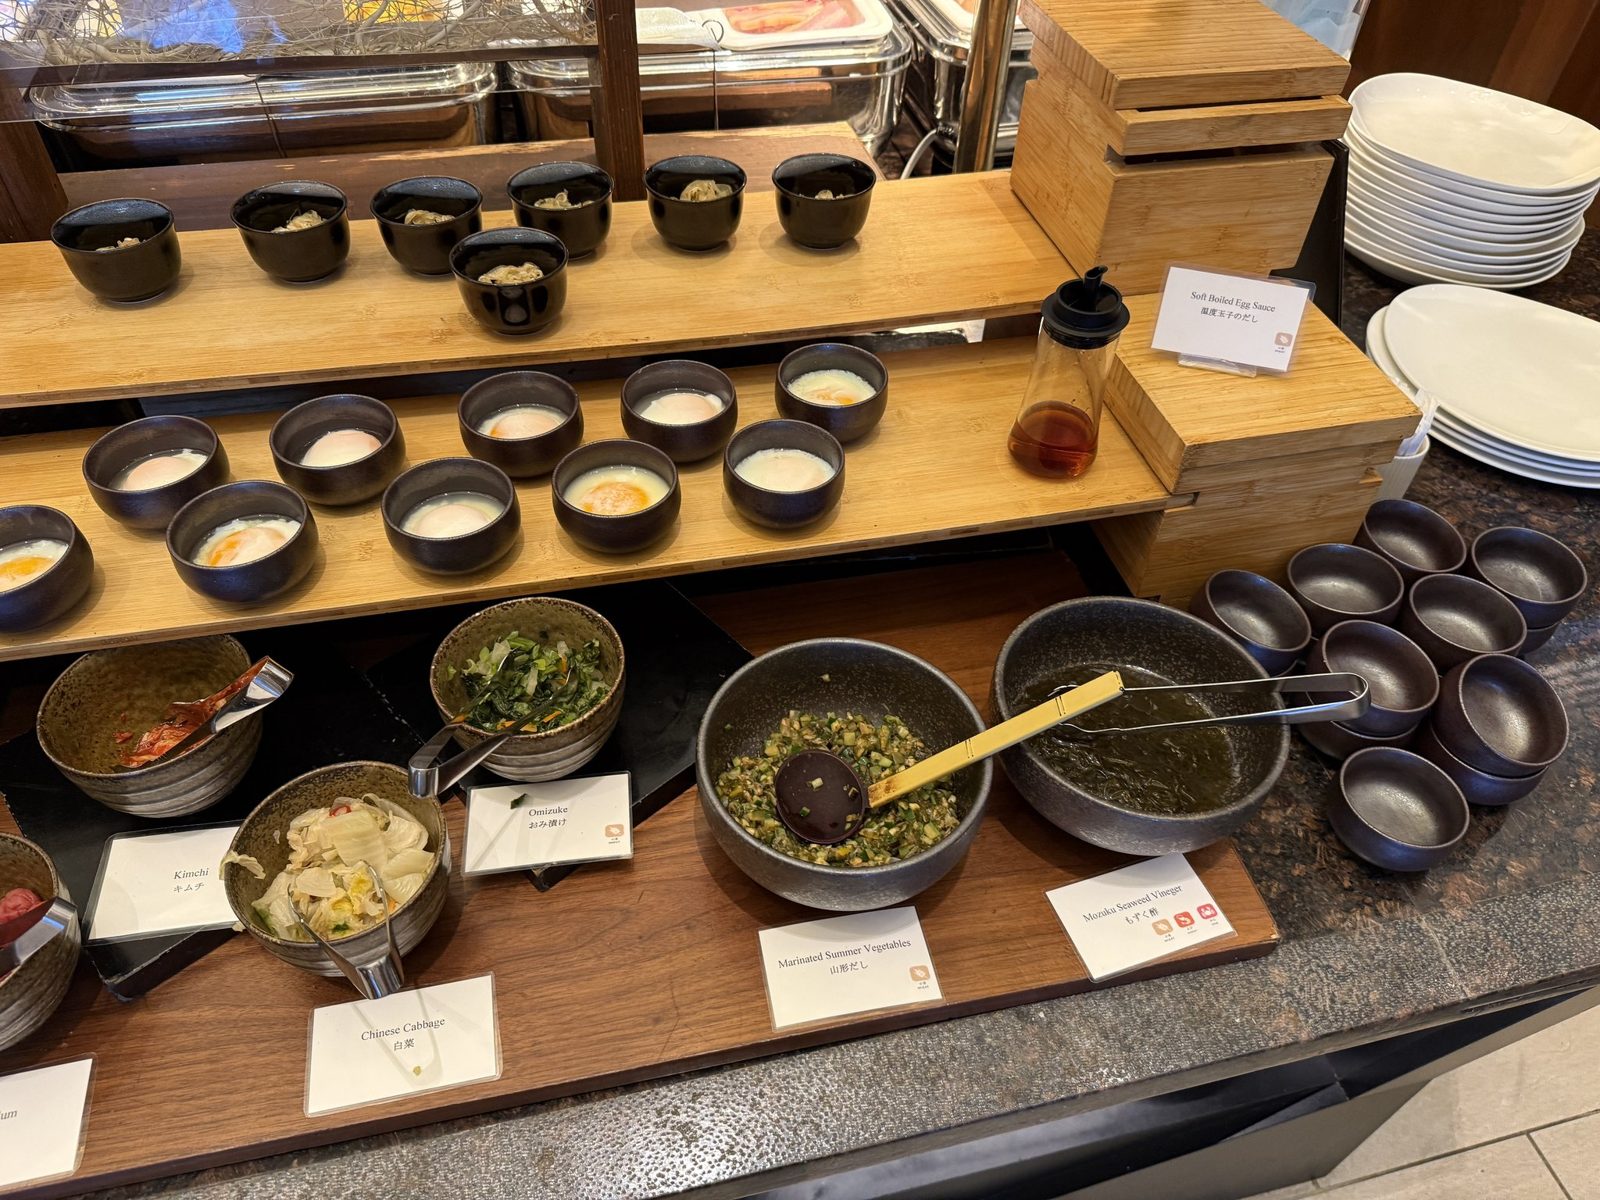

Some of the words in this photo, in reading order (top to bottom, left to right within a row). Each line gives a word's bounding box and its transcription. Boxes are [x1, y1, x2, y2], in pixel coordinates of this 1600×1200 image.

[1190, 291, 1207, 301] Soft
[1208, 294, 1235, 306] Boiled
[1235, 298, 1251, 310] Egg
[1252, 301, 1276, 313] Sauce
[1200, 307, 1258, 323] 温度玉子のだし
[528, 806, 569, 817] Omizuke
[528, 818, 567, 829] おみ漬け
[173, 868, 209, 880] Kimchi
[173, 882, 205, 893] キムチ
[1082, 907, 1117, 922] Mozuku
[1116, 894, 1152, 912] Seaweed
[1150, 885, 1183, 899] Vineger
[1125, 907, 1159, 925] もずく酢
[778, 952, 823, 968] Marinated
[825, 947, 862, 960] Summer
[863, 940, 911, 954] Vegetables
[829, 961, 869, 975] 山形だし
[361, 1027, 401, 1041] Chinese
[403, 1018, 446, 1033] Cabbage
[393, 1038, 415, 1052] 白菜
